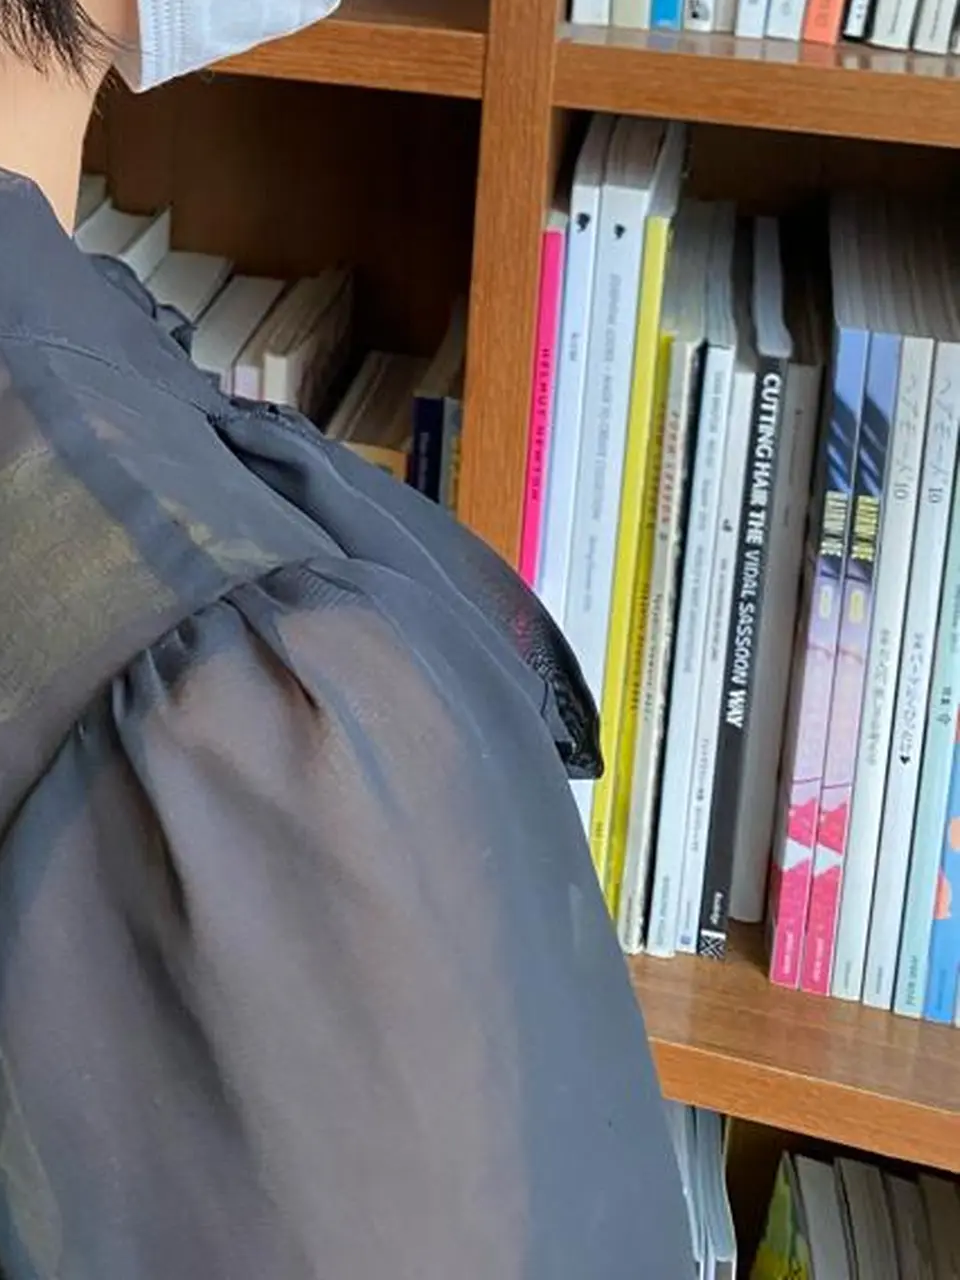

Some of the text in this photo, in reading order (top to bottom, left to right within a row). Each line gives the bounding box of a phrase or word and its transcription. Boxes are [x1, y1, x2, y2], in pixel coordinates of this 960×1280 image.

[537, 349, 552, 418] HELMUT
[725, 372, 783, 728] CUTTING HAIR THE VIDAL SASSOON WAY
